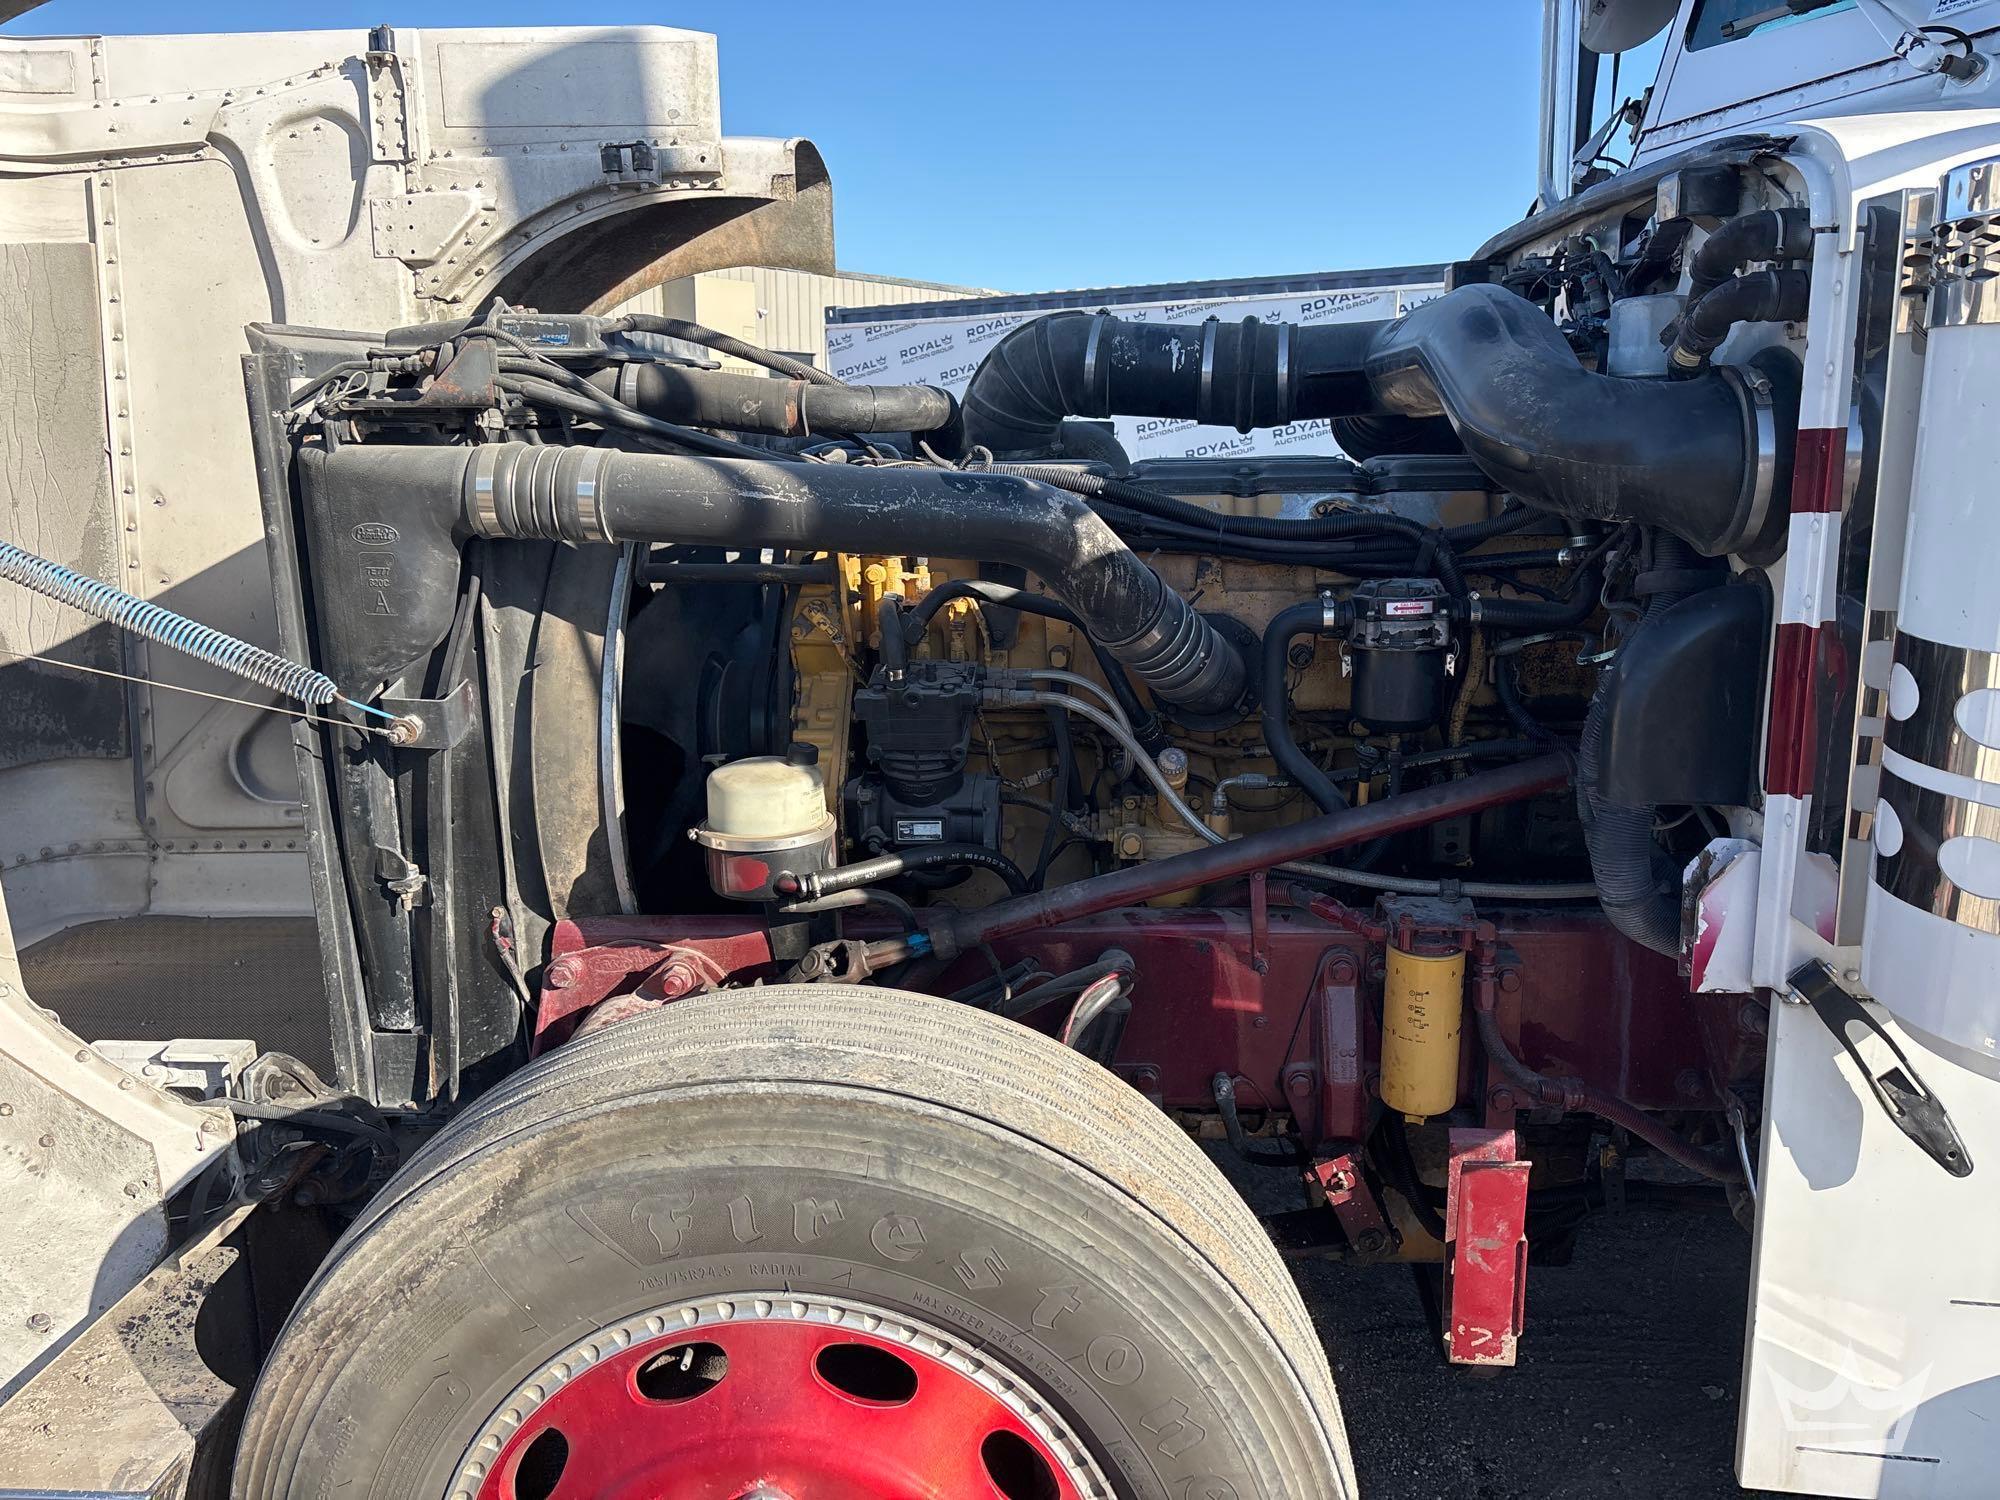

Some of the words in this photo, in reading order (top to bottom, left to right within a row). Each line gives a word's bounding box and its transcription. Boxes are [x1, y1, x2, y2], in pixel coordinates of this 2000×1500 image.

[1166, 305, 1204, 321] AUCTION
[1301, 292, 1361, 314] ROYAL
[1303, 304, 1344, 322] AUCTION
[1345, 295, 1379, 310] GROUP
[866, 329, 895, 342] AUCTION
[966, 316, 1011, 338] ROYAL
[968, 328, 1000, 345] AUCTION
[900, 339, 942, 359] ROYAL
[901, 351, 931, 365] AUCTION
[931, 344, 955, 357] GROUP
[837, 360, 877, 378] ROYAL
[867, 365, 889, 377] GROUP
[1136, 417, 1189, 434] ROYA
[1138, 427, 1174, 442] AUCTION
[1174, 422, 1199, 435] GROU
[1272, 418, 1330, 439] ROYAL
[1274, 431, 1321, 446] AUCTION
[1185, 440, 1239, 458] ROYAL
[1224, 446, 1256, 458] GROUP
[375, 590, 391, 613] A
[637, 1263, 733, 1292] 285/75R24.5
[749, 1262, 807, 1279] RADIAL
[912, 1291, 939, 1309] MAX
[943, 1304, 985, 1331] SPEED
